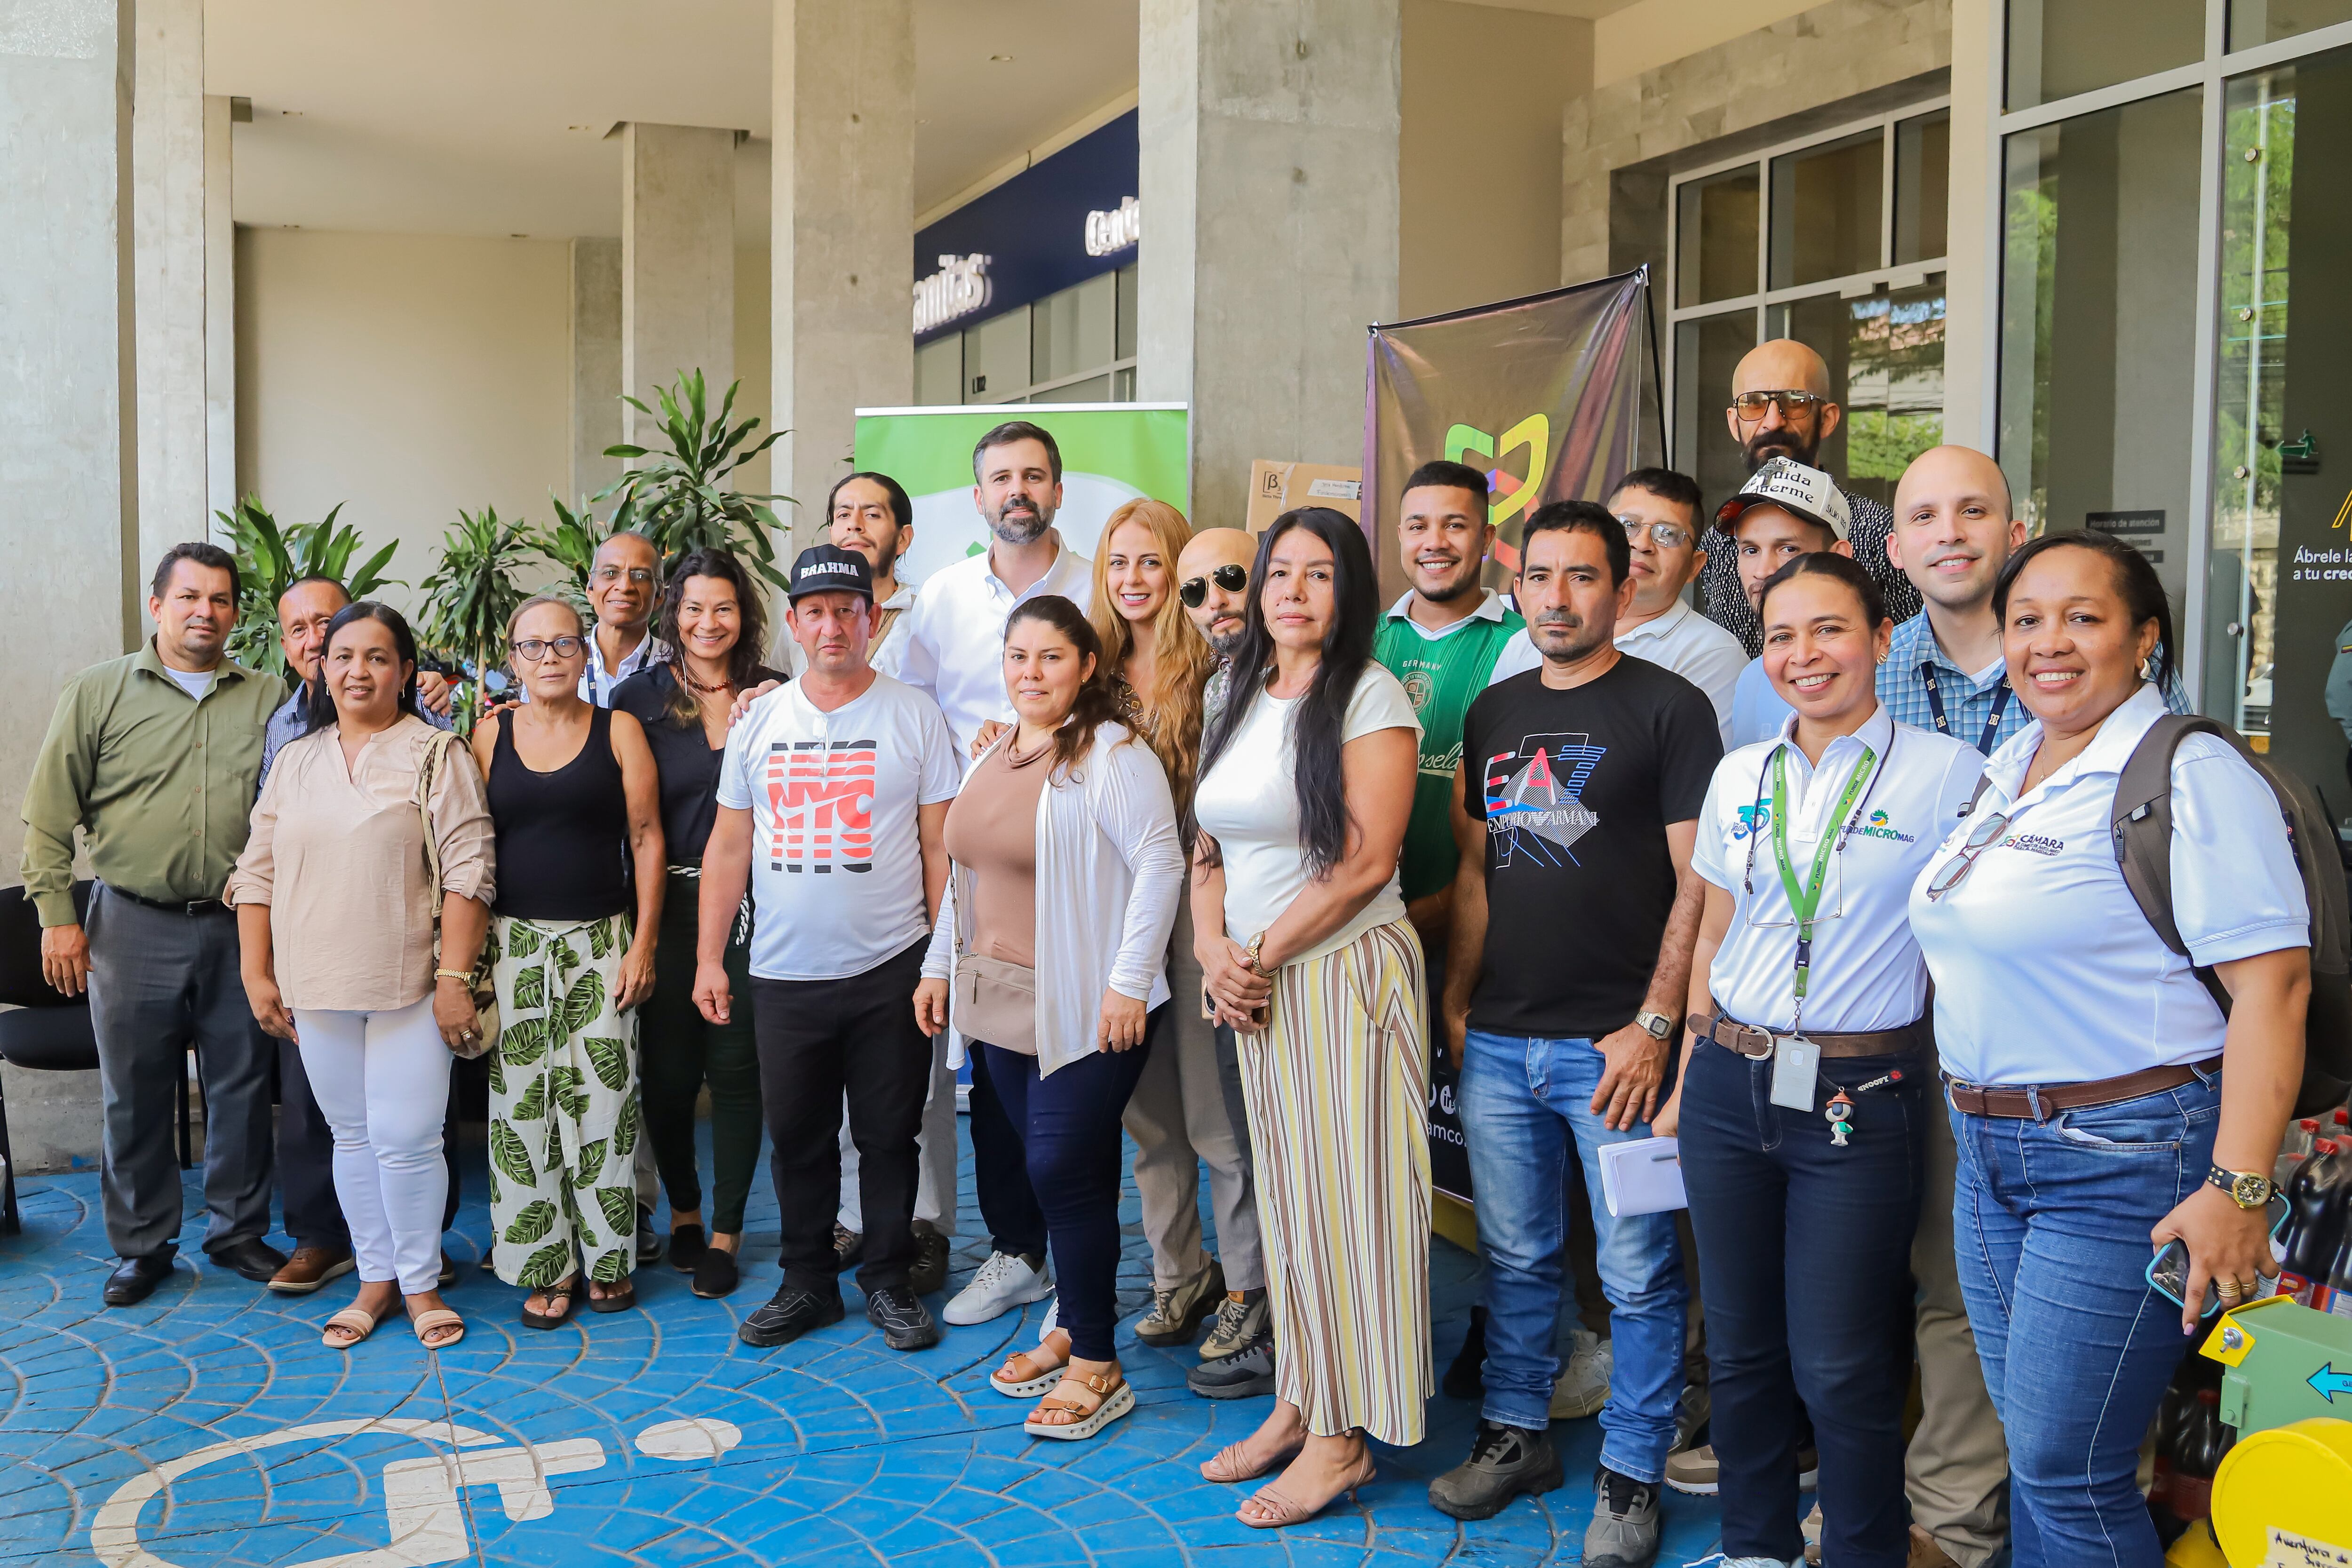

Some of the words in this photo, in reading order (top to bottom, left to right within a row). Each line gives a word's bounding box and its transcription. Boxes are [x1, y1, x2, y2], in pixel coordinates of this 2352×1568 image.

[1773, 471, 1811, 486] uida
[2118, 519, 2127, 527] de
[2294, 545, 2341, 563] Ábrele
[801, 562, 859, 580] BRAHMA
[2293, 569, 2301, 580] a
[2305, 567, 2320, 580] tu
[1402, 660, 1441, 671] GERMANY
[1848, 751, 1875, 796] FUNDEMICROMAG
[1487, 811, 1532, 833] EMPORIO
[1551, 811, 1597, 826] ARMANI
[1776, 823, 1786, 871] FUNDEMICROMAG
[2020, 835, 2064, 850] CÁMARA
[1815, 828, 1835, 879] FUNDEMICROMAG
[1858, 1075, 1889, 1091] SNOOPY
